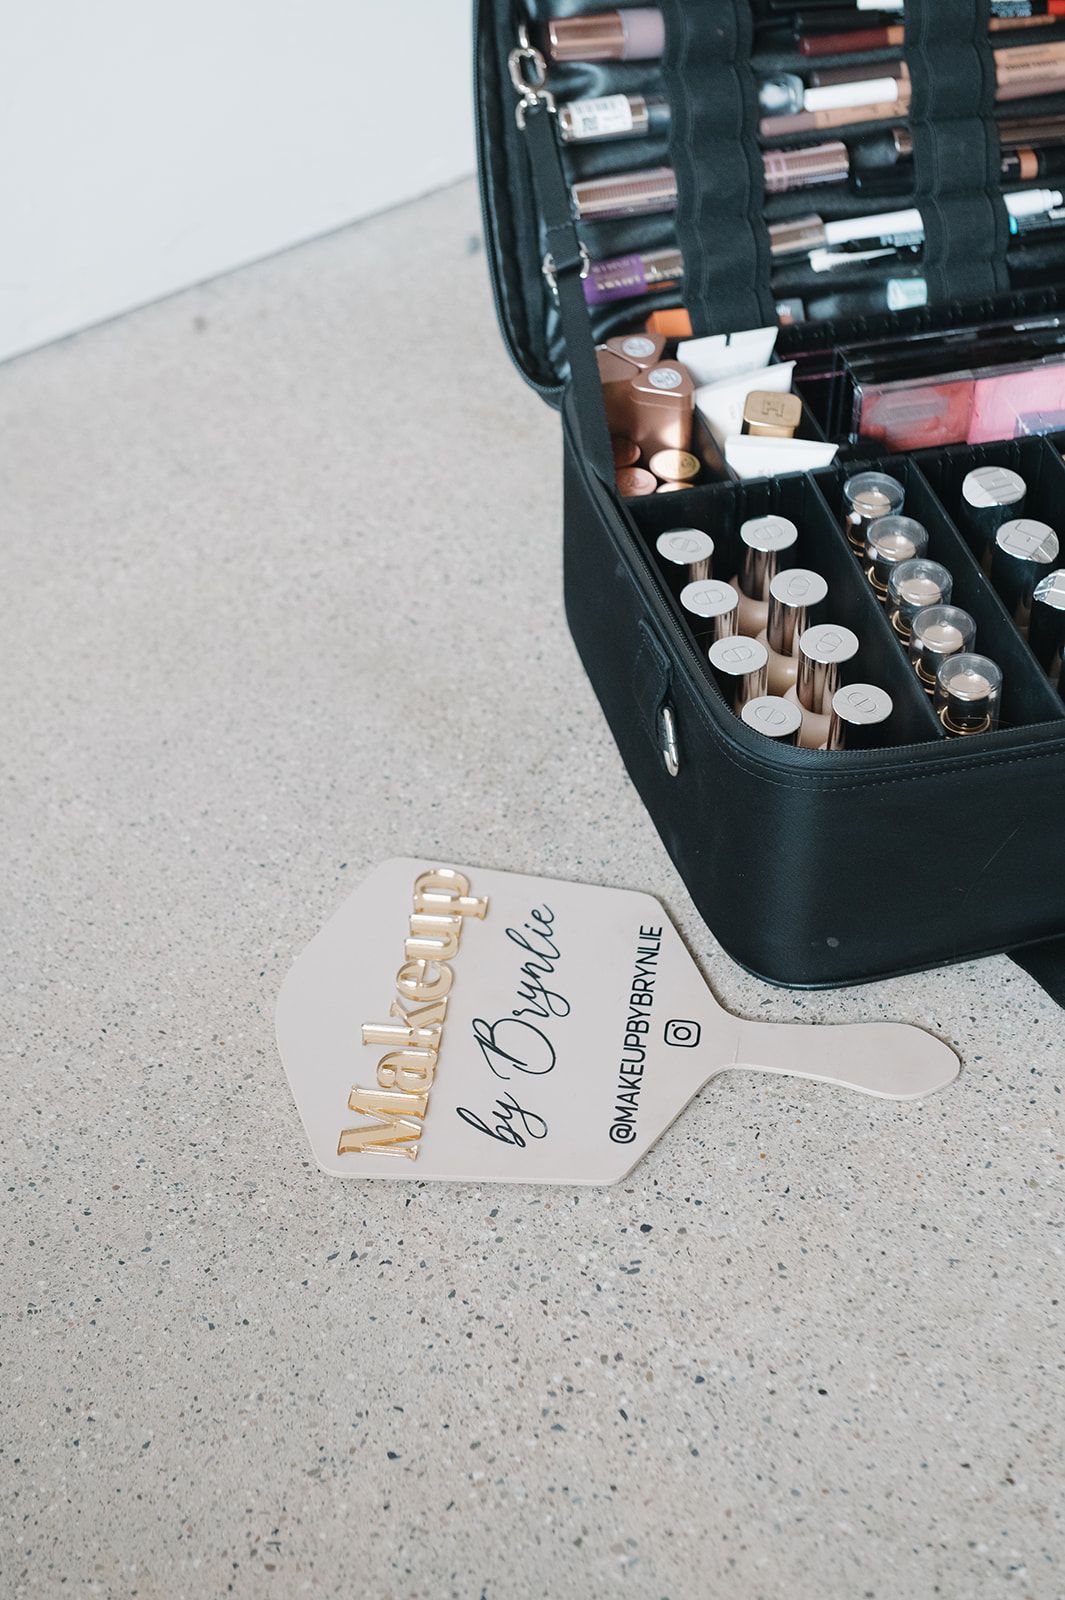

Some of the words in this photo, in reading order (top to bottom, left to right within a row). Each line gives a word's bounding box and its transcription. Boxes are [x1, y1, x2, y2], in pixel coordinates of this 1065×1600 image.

[337, 868, 490, 1161] Makeup
[471, 902, 571, 1080] Brynlie
[608, 924, 664, 1144] @MAKEUPBYBRYNLIE
[456, 1090, 549, 1148] by
